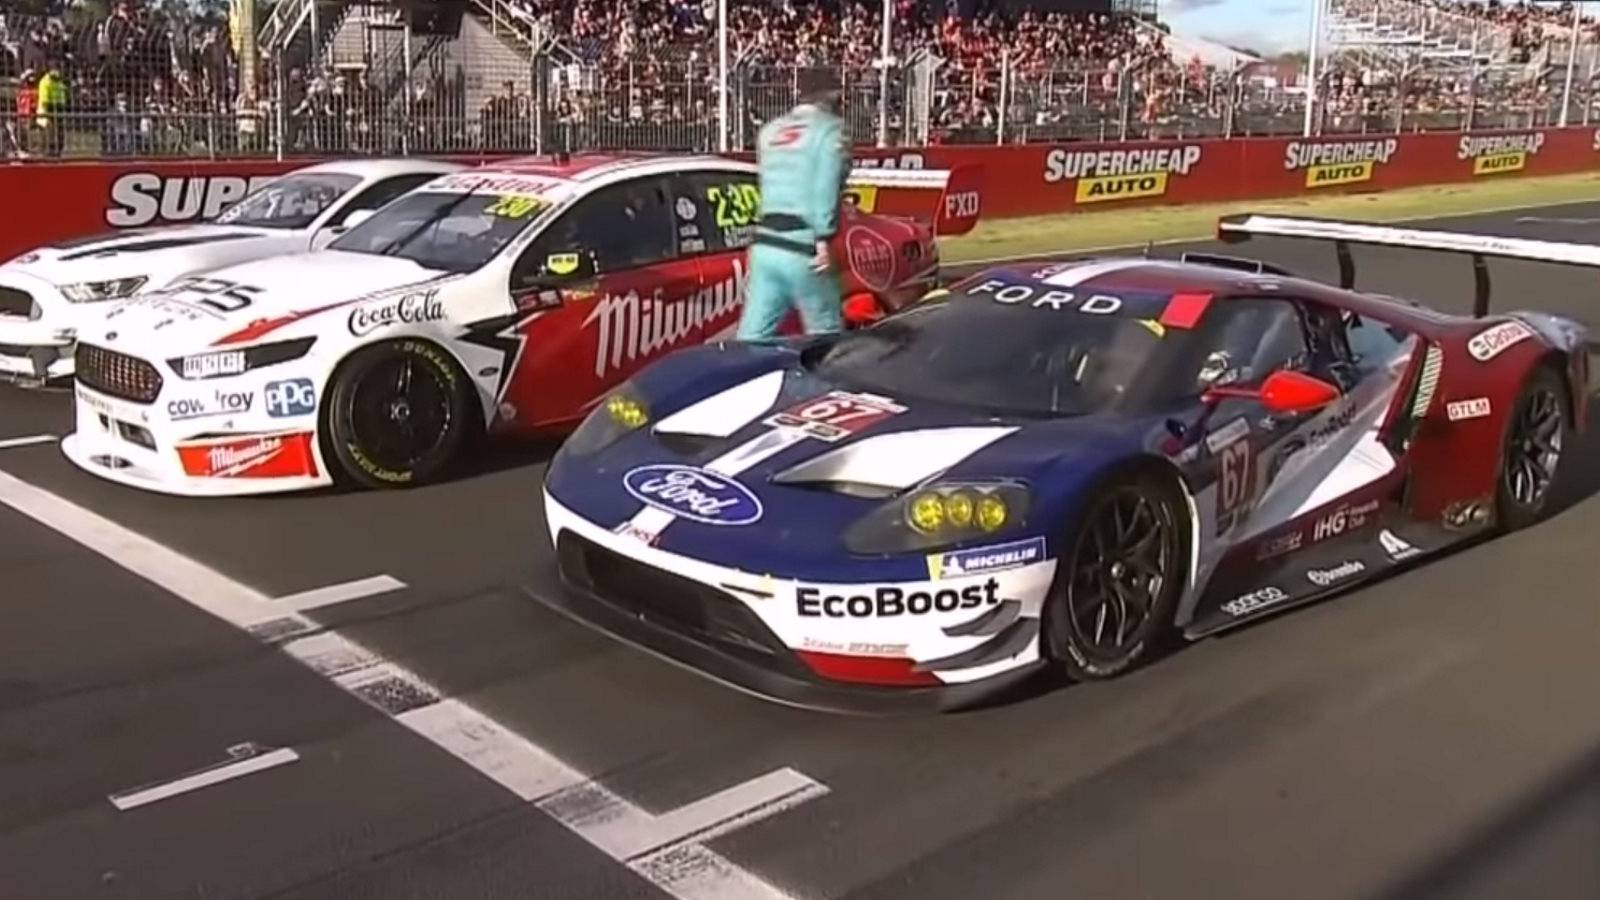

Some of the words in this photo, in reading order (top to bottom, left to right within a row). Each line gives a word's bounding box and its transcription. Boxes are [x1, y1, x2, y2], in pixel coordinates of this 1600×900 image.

[1284, 138, 1398, 169] SUPERCHEAP
[1457, 132, 1544, 159] SUPERCHEAP
[1044, 145, 1200, 182] SUPERCHEAP
[1314, 165, 1365, 182] AUTO
[1481, 155, 1520, 169] AUTO
[1087, 176, 1157, 196] AUTO
[708, 183, 761, 227] 230
[945, 192, 979, 219] FXD
[967, 280, 1122, 315] FORD
[581, 258, 749, 378] Milwauk
[267, 381, 313, 415] PPG
[801, 400, 884, 424] 67
[1450, 400, 1488, 418] GTLM
[1222, 439, 1250, 511] 67
[639, 470, 740, 516] Ford
[1313, 510, 1347, 542] IHG
[964, 548, 1038, 570] MICHELIN
[796, 577, 1000, 618] EcoBoost
